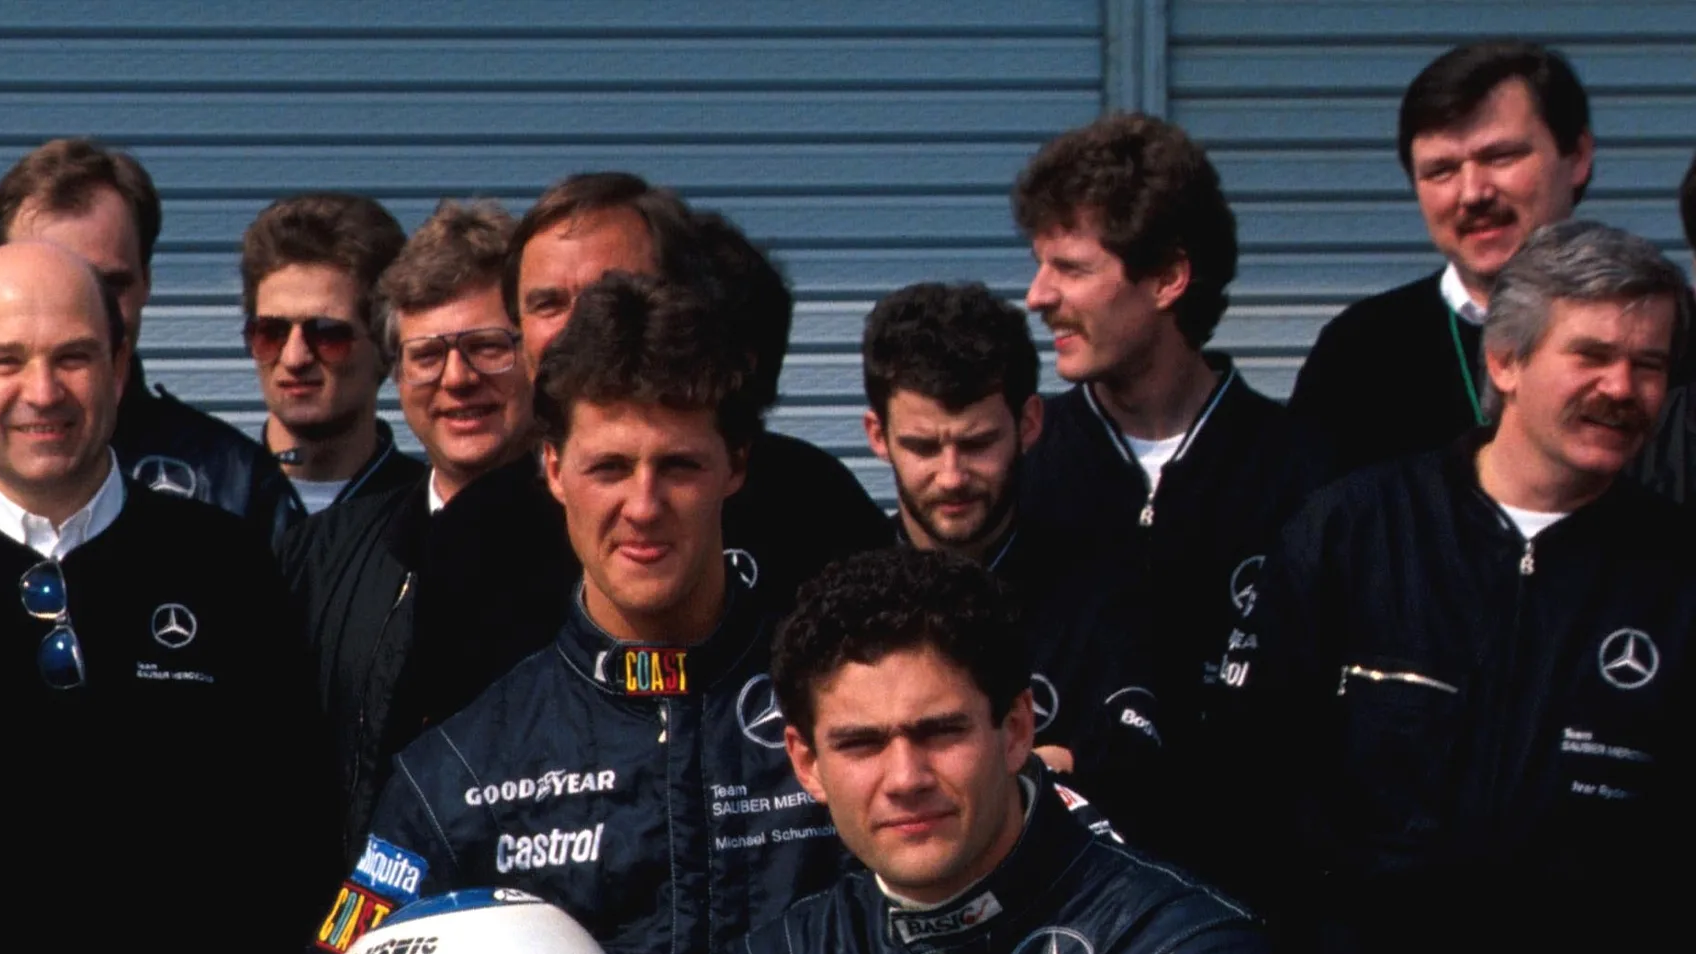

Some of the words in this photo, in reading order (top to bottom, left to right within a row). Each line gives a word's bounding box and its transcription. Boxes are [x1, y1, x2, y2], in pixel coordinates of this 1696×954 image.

[625, 650, 689, 693] COAST
[464, 768, 616, 807] GOODYEAR
[710, 783, 748, 799] Team
[496, 822, 605, 874] Castrol
